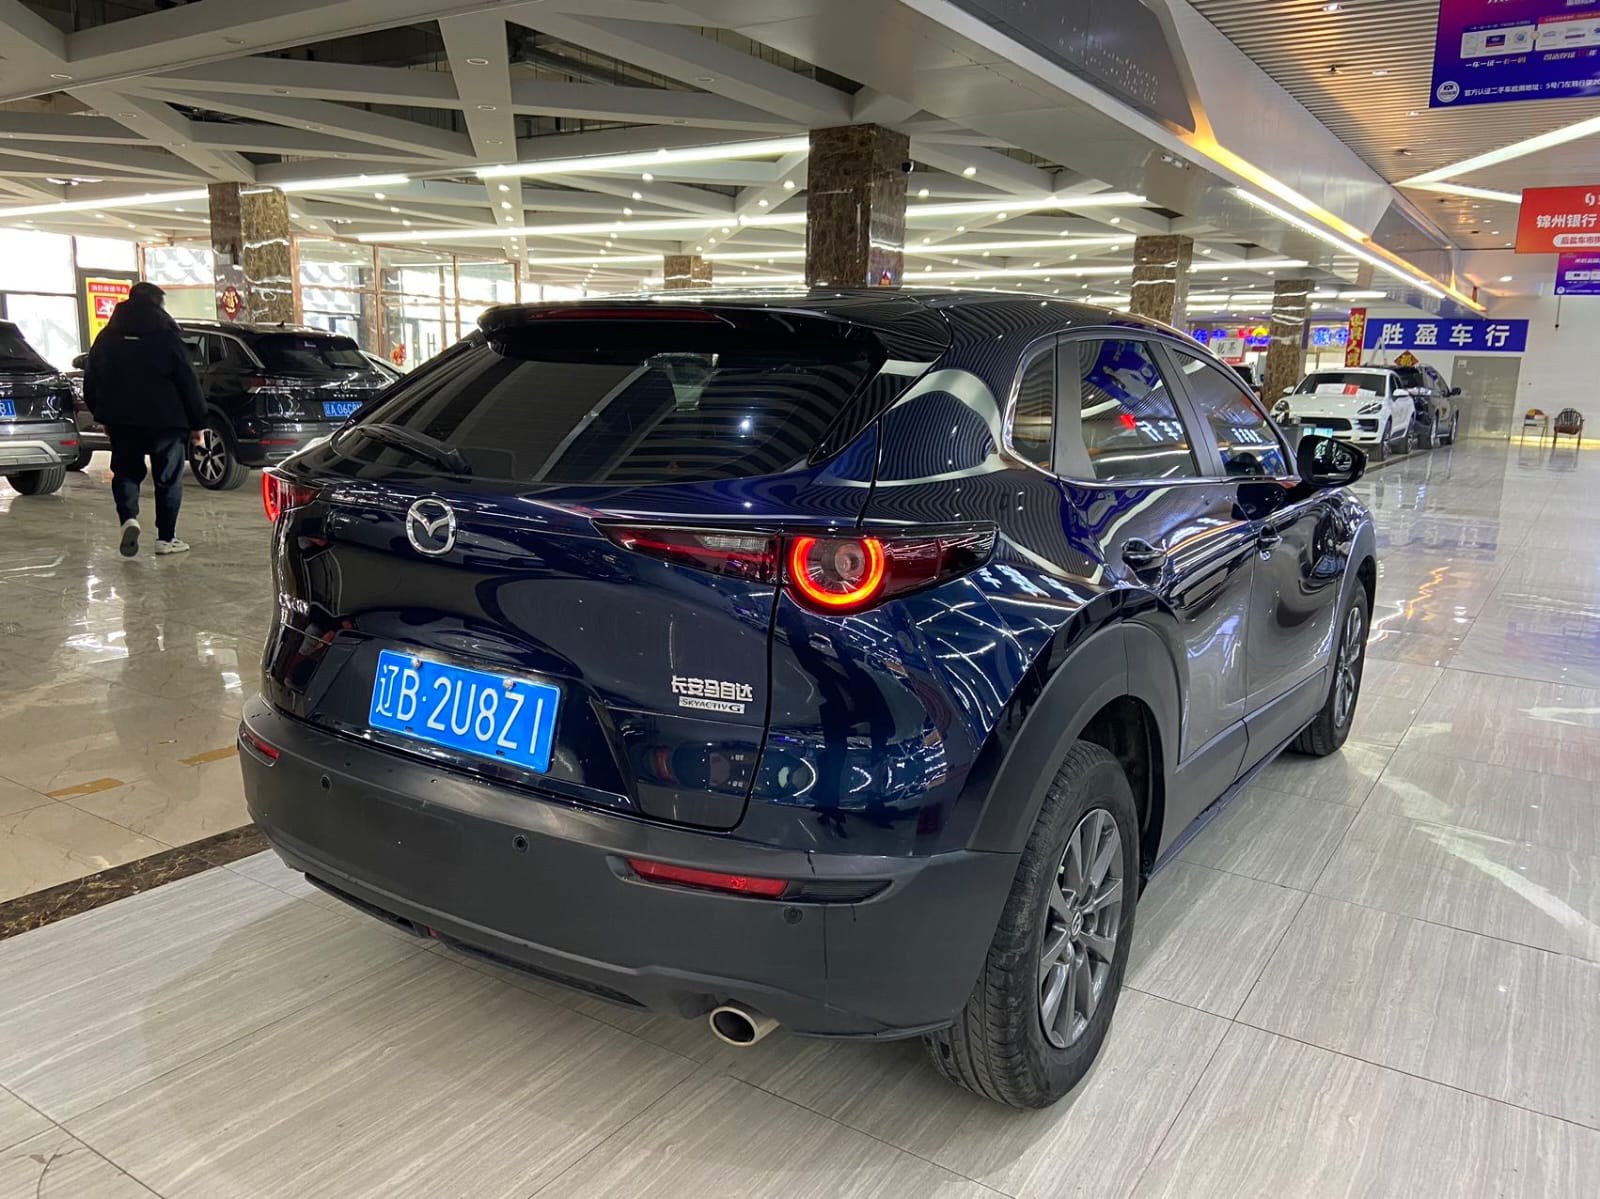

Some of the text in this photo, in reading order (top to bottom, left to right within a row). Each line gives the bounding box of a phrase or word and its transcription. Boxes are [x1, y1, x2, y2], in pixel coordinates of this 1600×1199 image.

[1536, 213, 1598, 229] 锦州银行
[1381, 322, 1510, 347] 胜盈车行
[671, 675, 753, 702] 长安马自达
